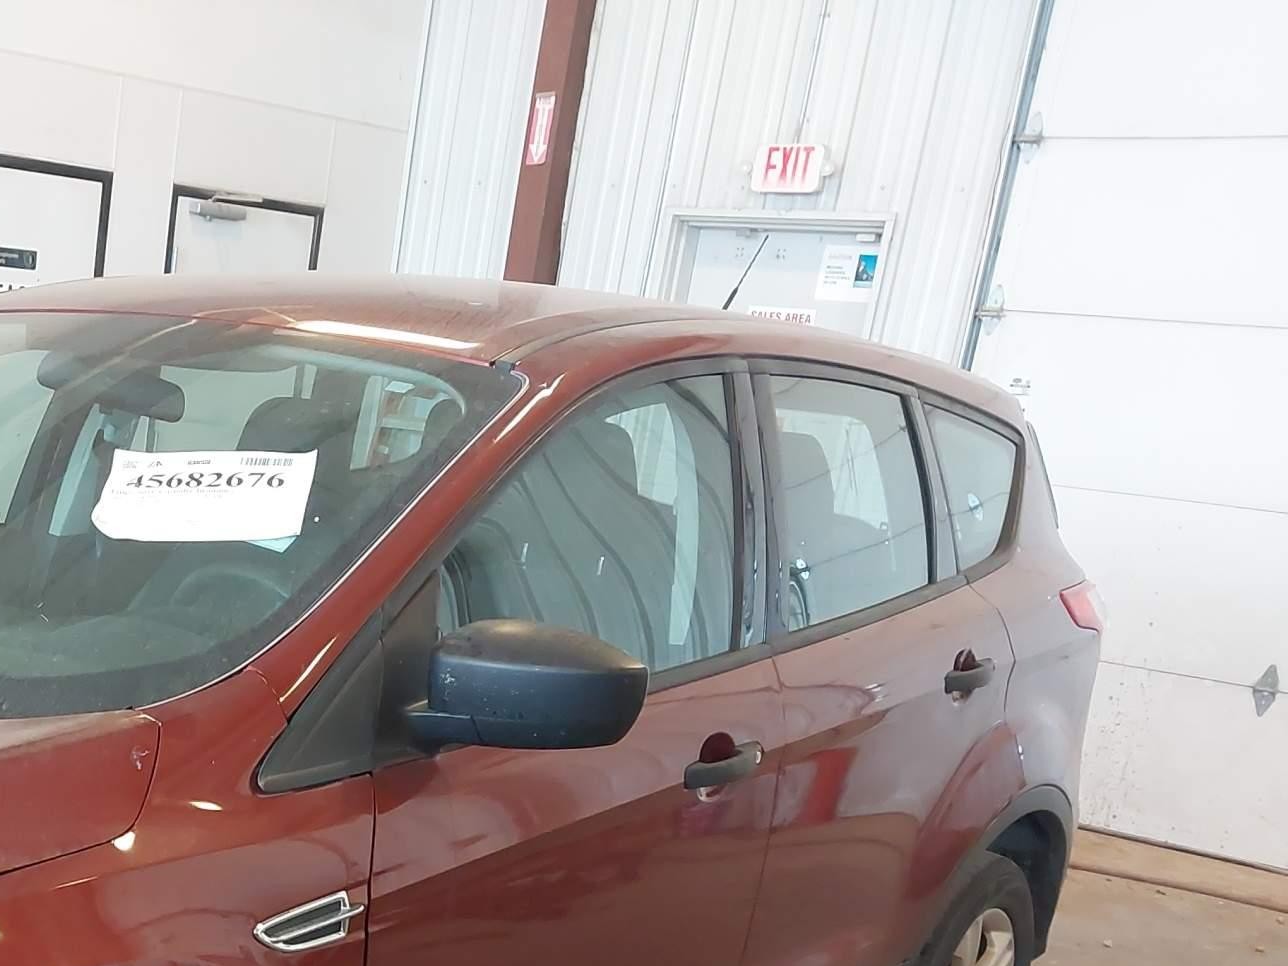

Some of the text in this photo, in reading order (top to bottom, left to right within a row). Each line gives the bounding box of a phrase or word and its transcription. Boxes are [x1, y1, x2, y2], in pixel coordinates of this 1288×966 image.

[762, 146, 816, 185] EXIT
[785, 312, 811, 324] AREA
[126, 471, 285, 488] 45682676
